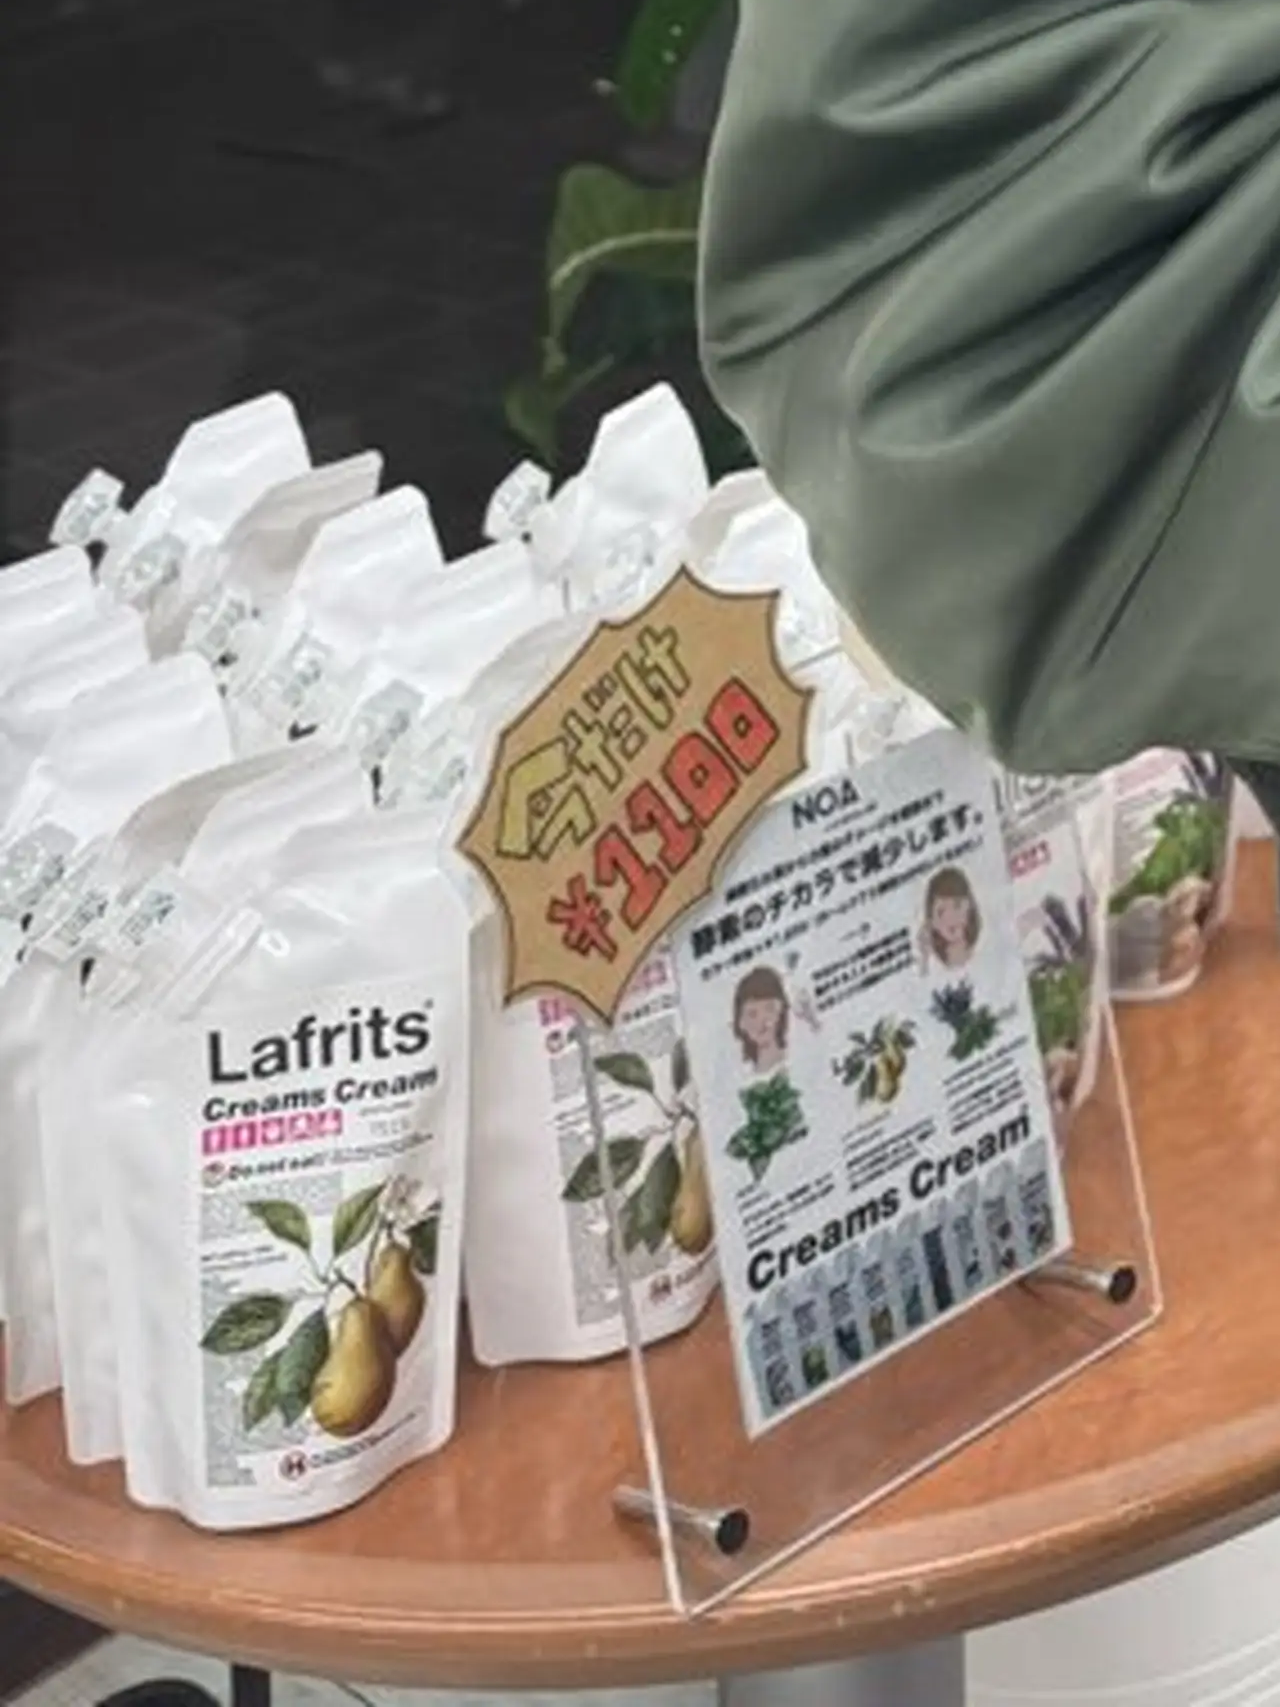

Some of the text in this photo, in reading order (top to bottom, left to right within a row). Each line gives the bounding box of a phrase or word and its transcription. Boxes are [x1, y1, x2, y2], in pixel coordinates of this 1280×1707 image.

[495, 625, 692, 862] 今だけ
[791, 779, 860, 828] NOA
[546, 676, 781, 962] ¥1100
[203, 1087, 327, 1122] Creams
[334, 1066, 438, 1104] Cream
[207, 1005, 431, 1084] Lafrits
[747, 1187, 900, 1292] Creams
[909, 1112, 1030, 1201] Cream
